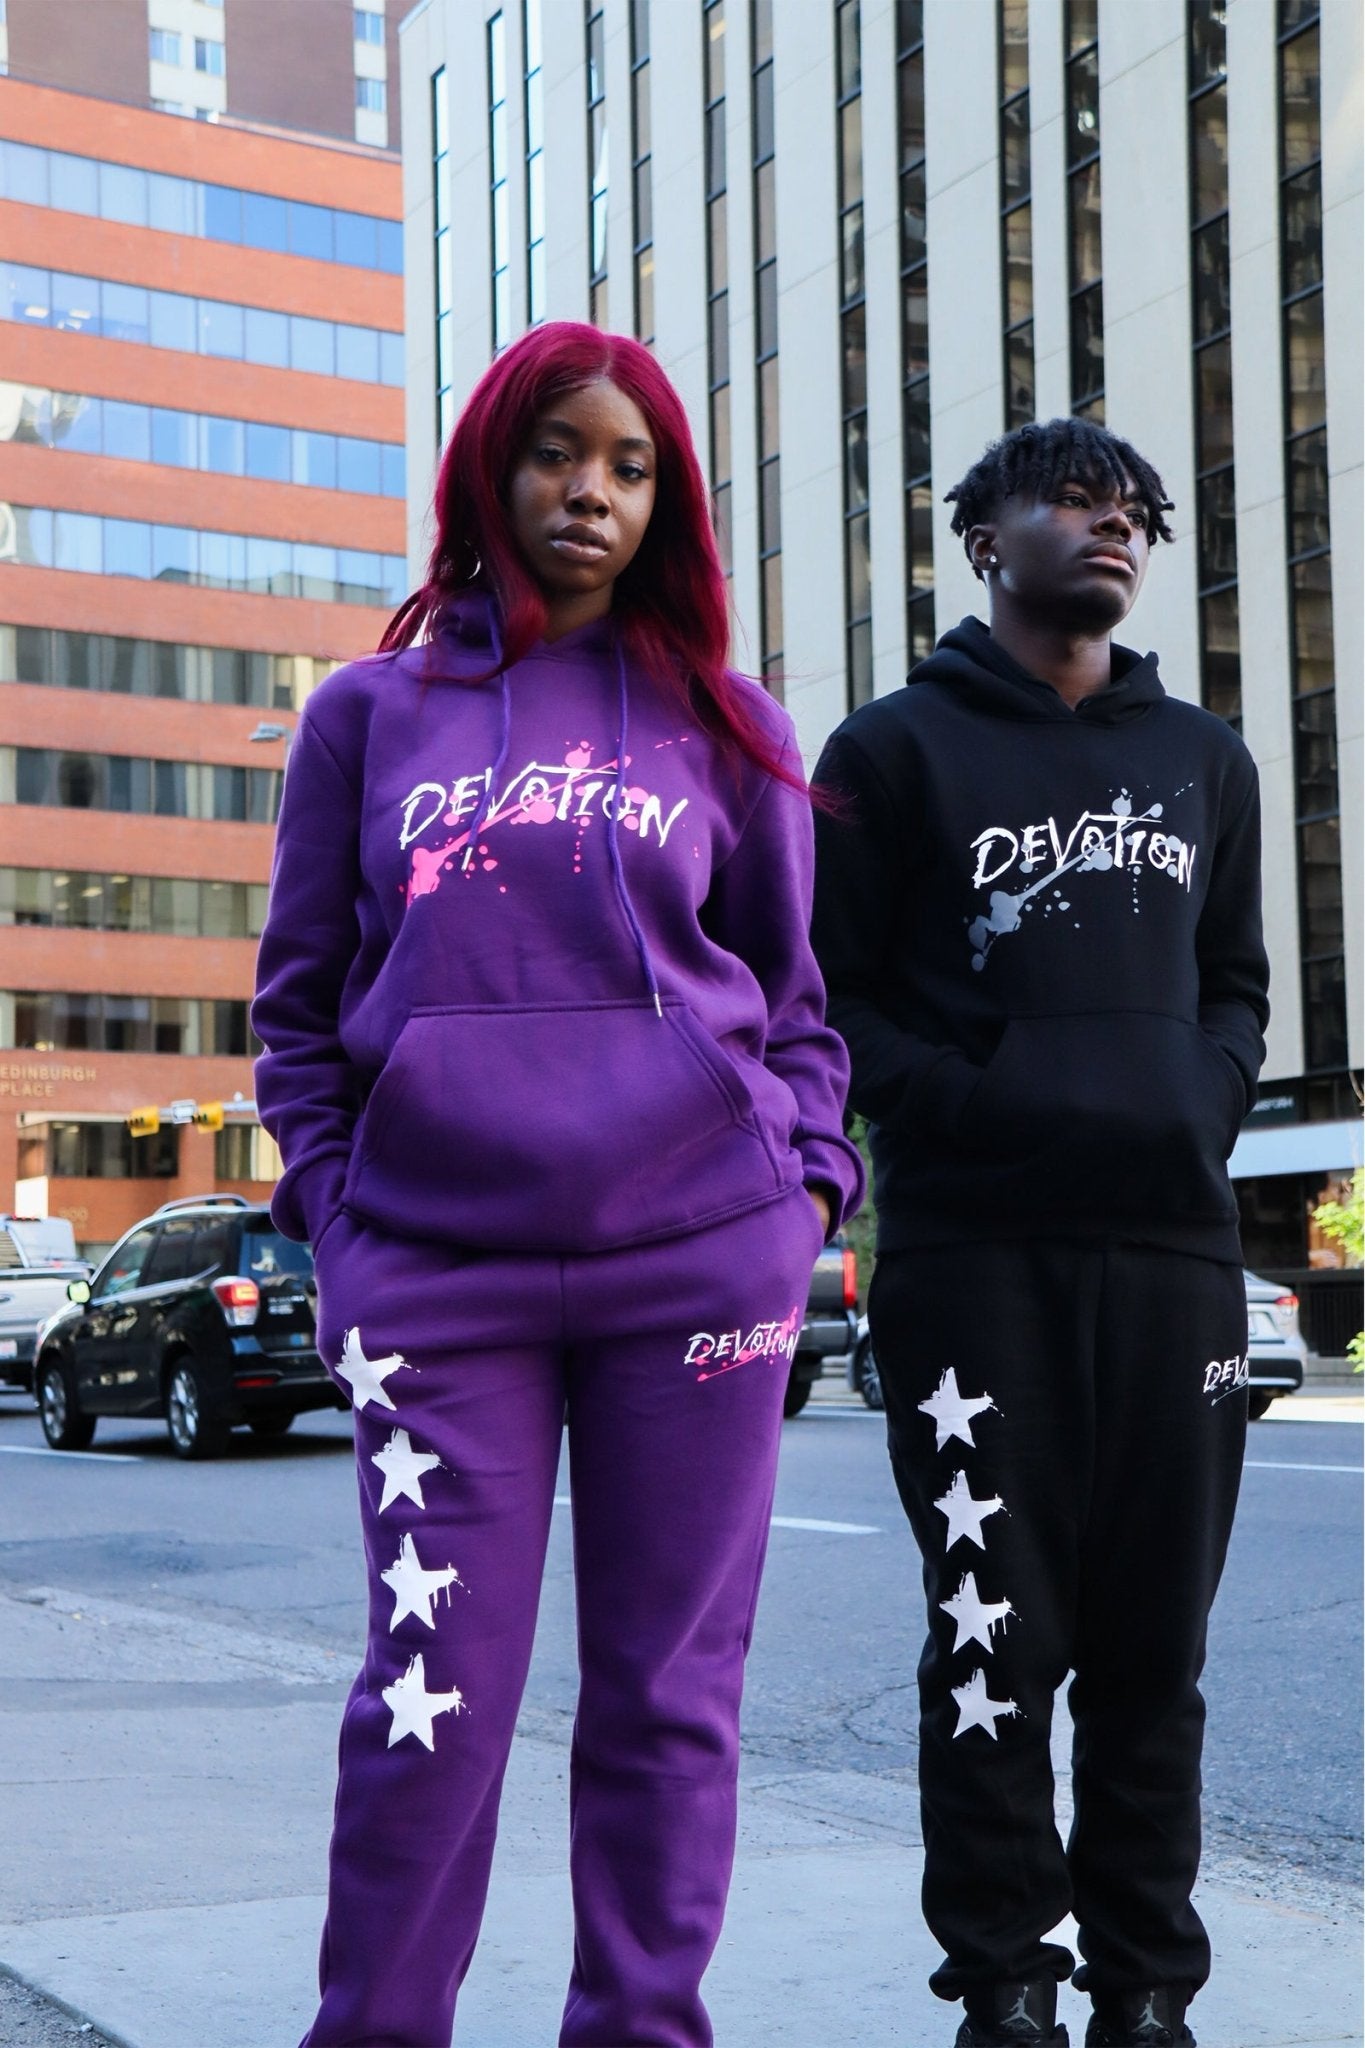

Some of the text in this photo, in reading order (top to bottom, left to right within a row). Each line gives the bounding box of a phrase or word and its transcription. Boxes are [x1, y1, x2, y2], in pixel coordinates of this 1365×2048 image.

[398, 760, 689, 849] DEVOTION
[969, 810, 1196, 893] DEVOTION
[0, 1063, 97, 1081] EDINBURGH
[0, 1081, 55, 1097] PLACE
